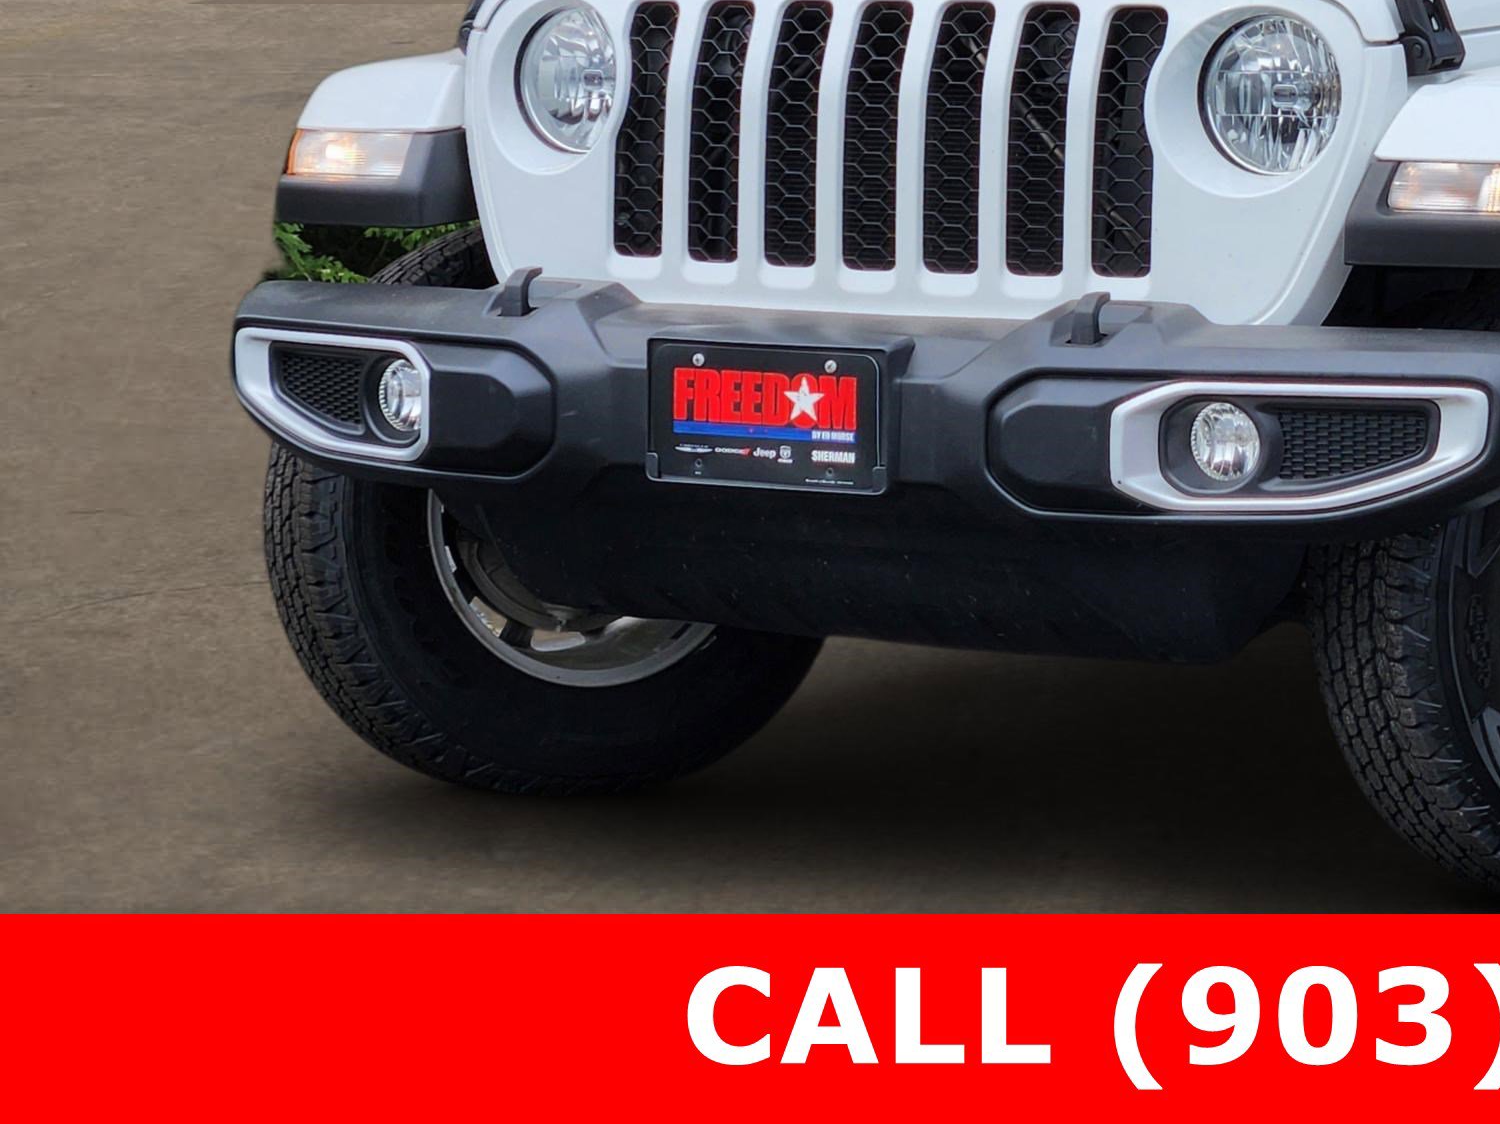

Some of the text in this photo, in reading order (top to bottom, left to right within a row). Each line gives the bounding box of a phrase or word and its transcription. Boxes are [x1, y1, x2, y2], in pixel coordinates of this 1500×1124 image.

[673, 367, 857, 431] FREEDOM
[753, 446, 777, 459] Jeep
[811, 450, 856, 464] SHERMAN
